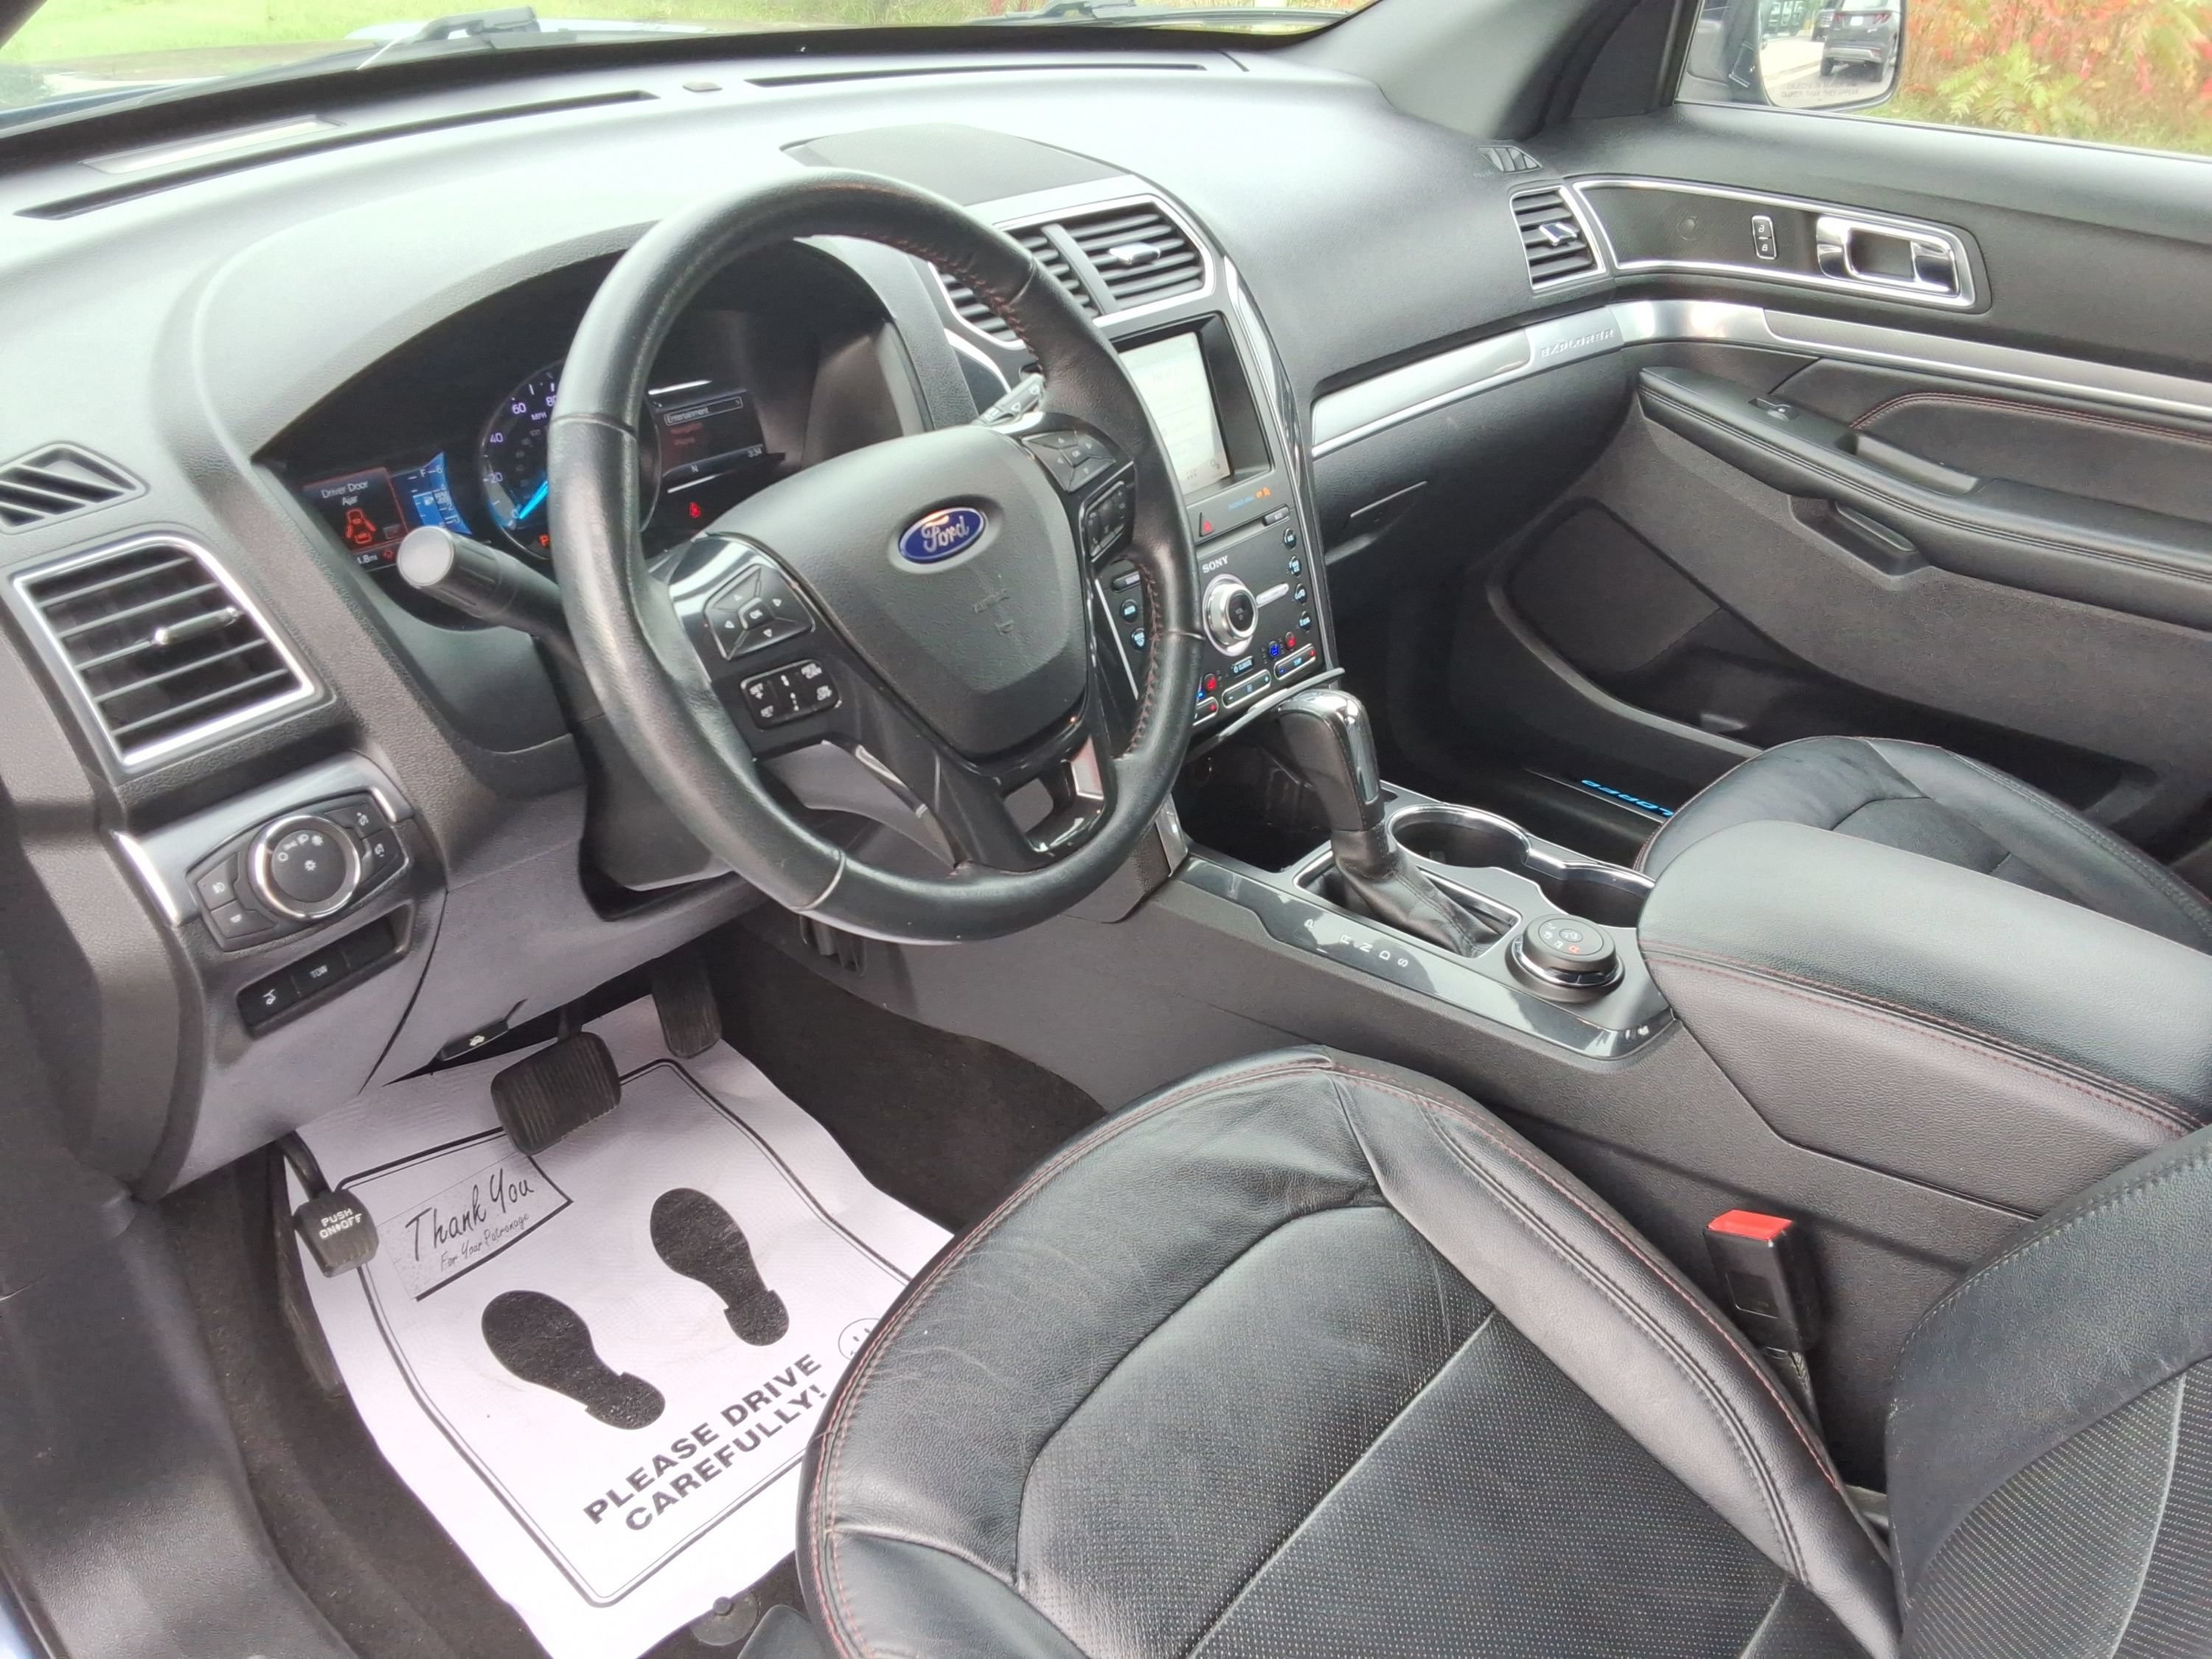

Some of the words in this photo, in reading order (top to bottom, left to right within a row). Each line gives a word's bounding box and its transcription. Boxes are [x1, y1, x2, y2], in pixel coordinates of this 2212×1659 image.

[1540, 329, 1614, 358] EXPLORER
[512, 403, 526, 414] 60
[531, 411, 547, 420] MPH
[667, 408, 709, 423] Entertainment
[490, 432, 504, 444] 40
[420, 468, 426, 477] F
[489, 472, 504, 484] 20
[321, 486, 347, 498] Driver
[347, 481, 368, 493] Door
[341, 495, 358, 506] Ajar
[921, 515, 970, 552] Ford
[1202, 555, 1229, 574] SONY
[1304, 919, 1315, 929] P
[1340, 934, 1352, 945] R
[1360, 942, 1374, 953] N
[1379, 950, 1391, 961] D
[1397, 958, 1408, 967] S
[310, 964, 327, 978] TOW
[321, 1207, 353, 1227] PUSH
[405, 1185, 487, 1262] Thank
[490, 1167, 535, 1213] You
[441, 1251, 459, 1269] For
[461, 1239, 483, 1259] Your
[484, 1212, 530, 1247] Patronage
[582, 1422, 720, 1525] PLEASE
[720, 1354, 822, 1427] DRIVE
[625, 1384, 827, 1531] CAREFULLY!
